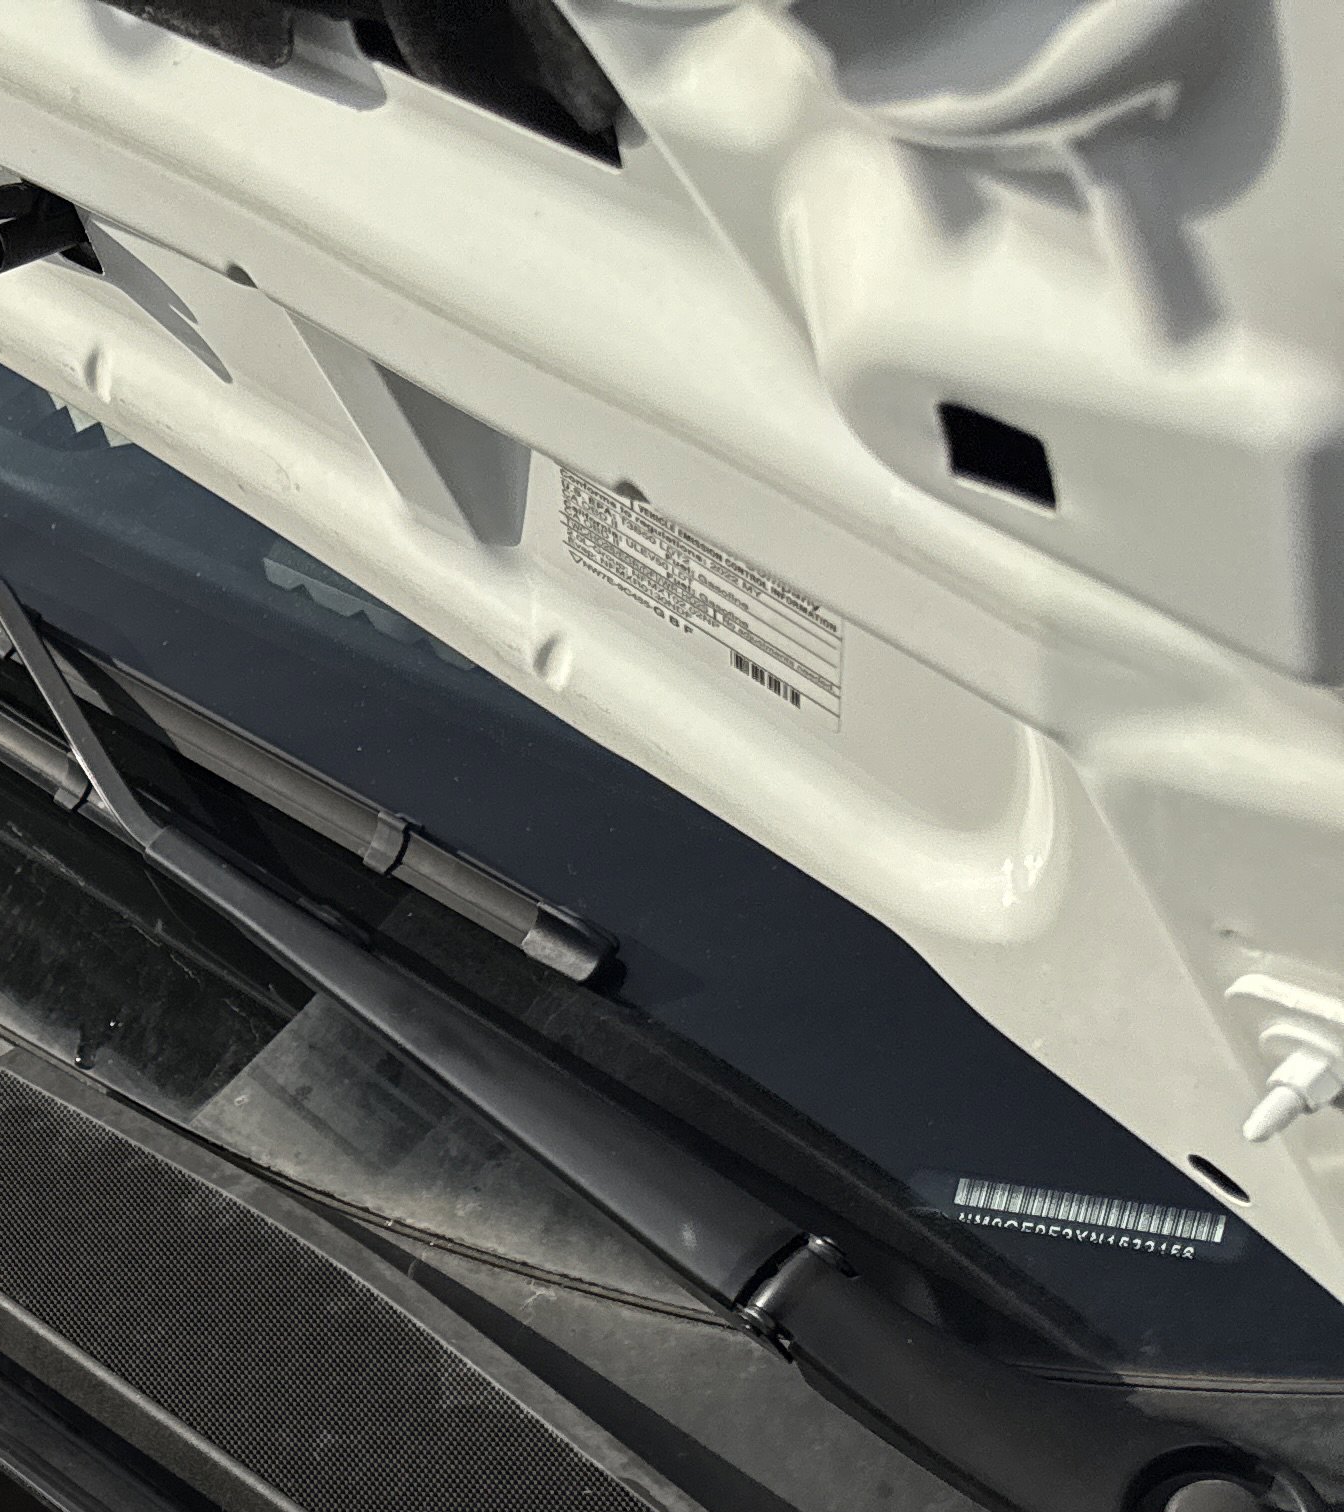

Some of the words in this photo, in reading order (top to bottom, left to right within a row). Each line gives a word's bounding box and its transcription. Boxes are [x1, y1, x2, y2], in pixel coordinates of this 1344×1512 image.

[559, 466, 617, 509] Conforms
[709, 560, 738, 586] 2022
[741, 580, 762, 600] MY
[636, 502, 674, 533] VEHICLE
[677, 527, 722, 563] EMISSION
[724, 556, 767, 590] CONTROL
[770, 584, 837, 634] INFORMATION
[698, 572, 749, 613] Gasoline
